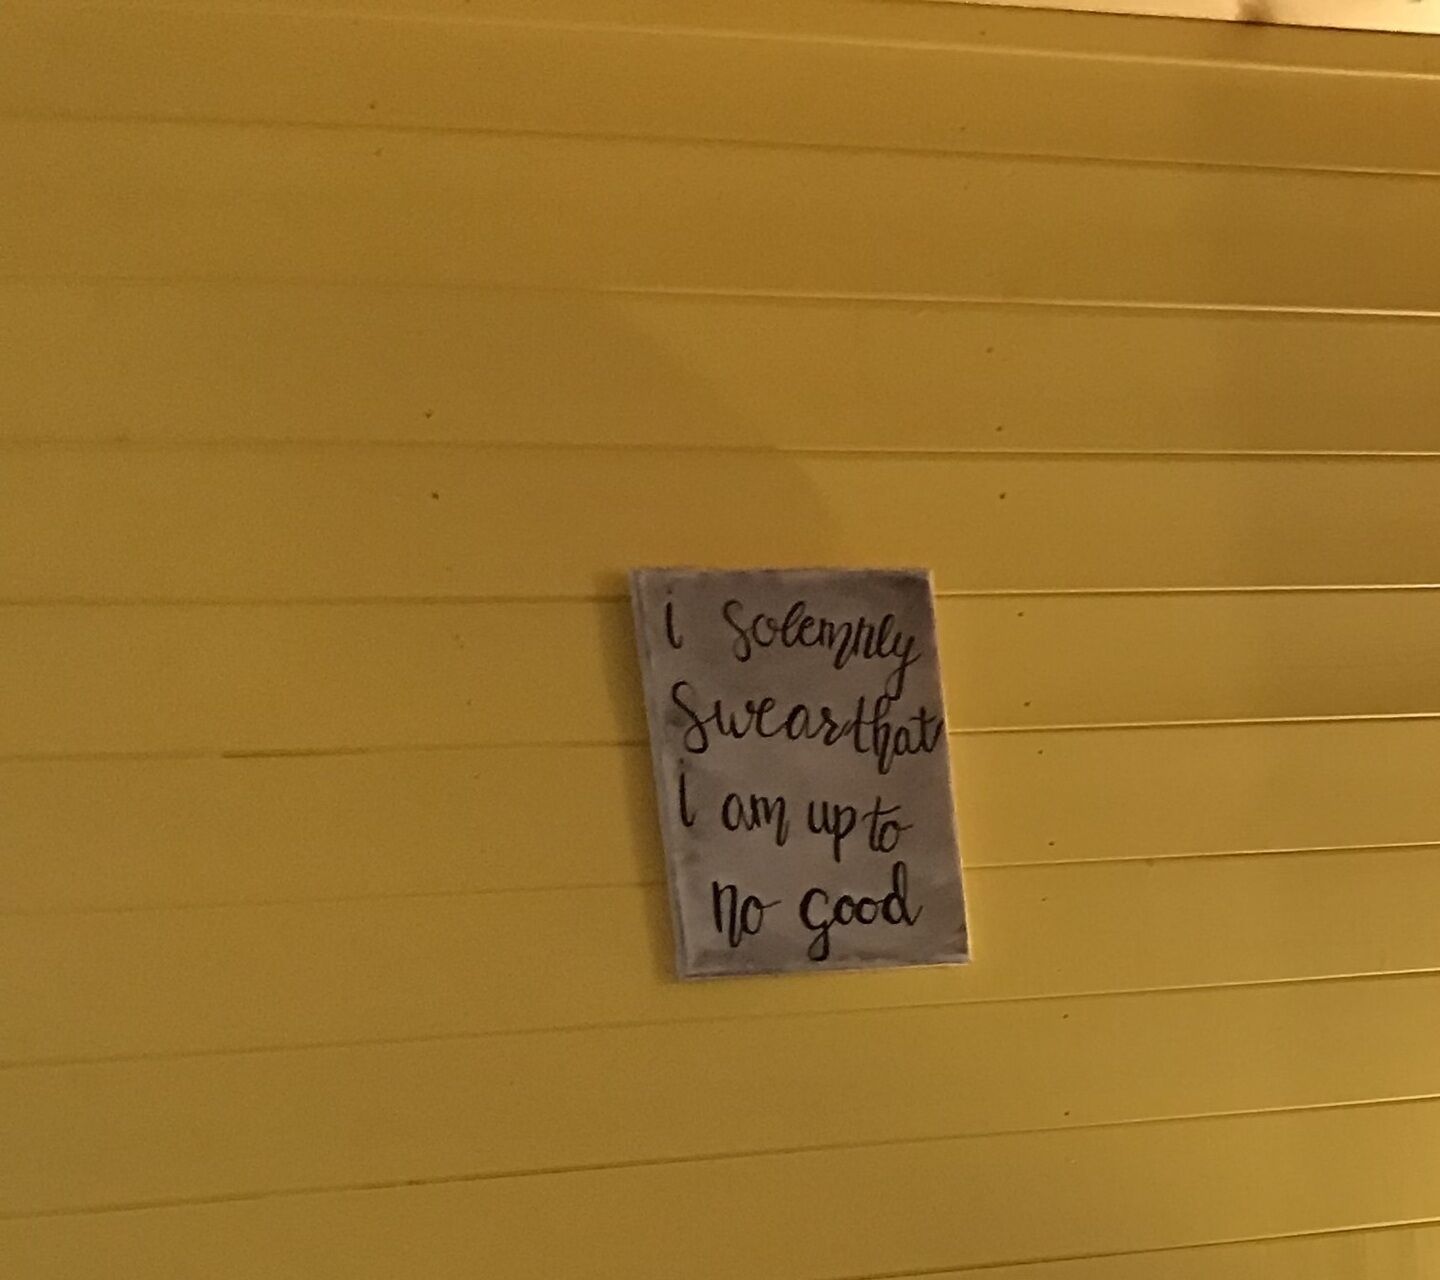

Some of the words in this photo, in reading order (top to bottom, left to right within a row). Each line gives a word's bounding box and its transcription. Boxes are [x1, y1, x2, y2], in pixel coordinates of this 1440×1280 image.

[722, 792, 789, 847] am
[807, 799, 857, 862] up
[862, 796, 914, 853] to
